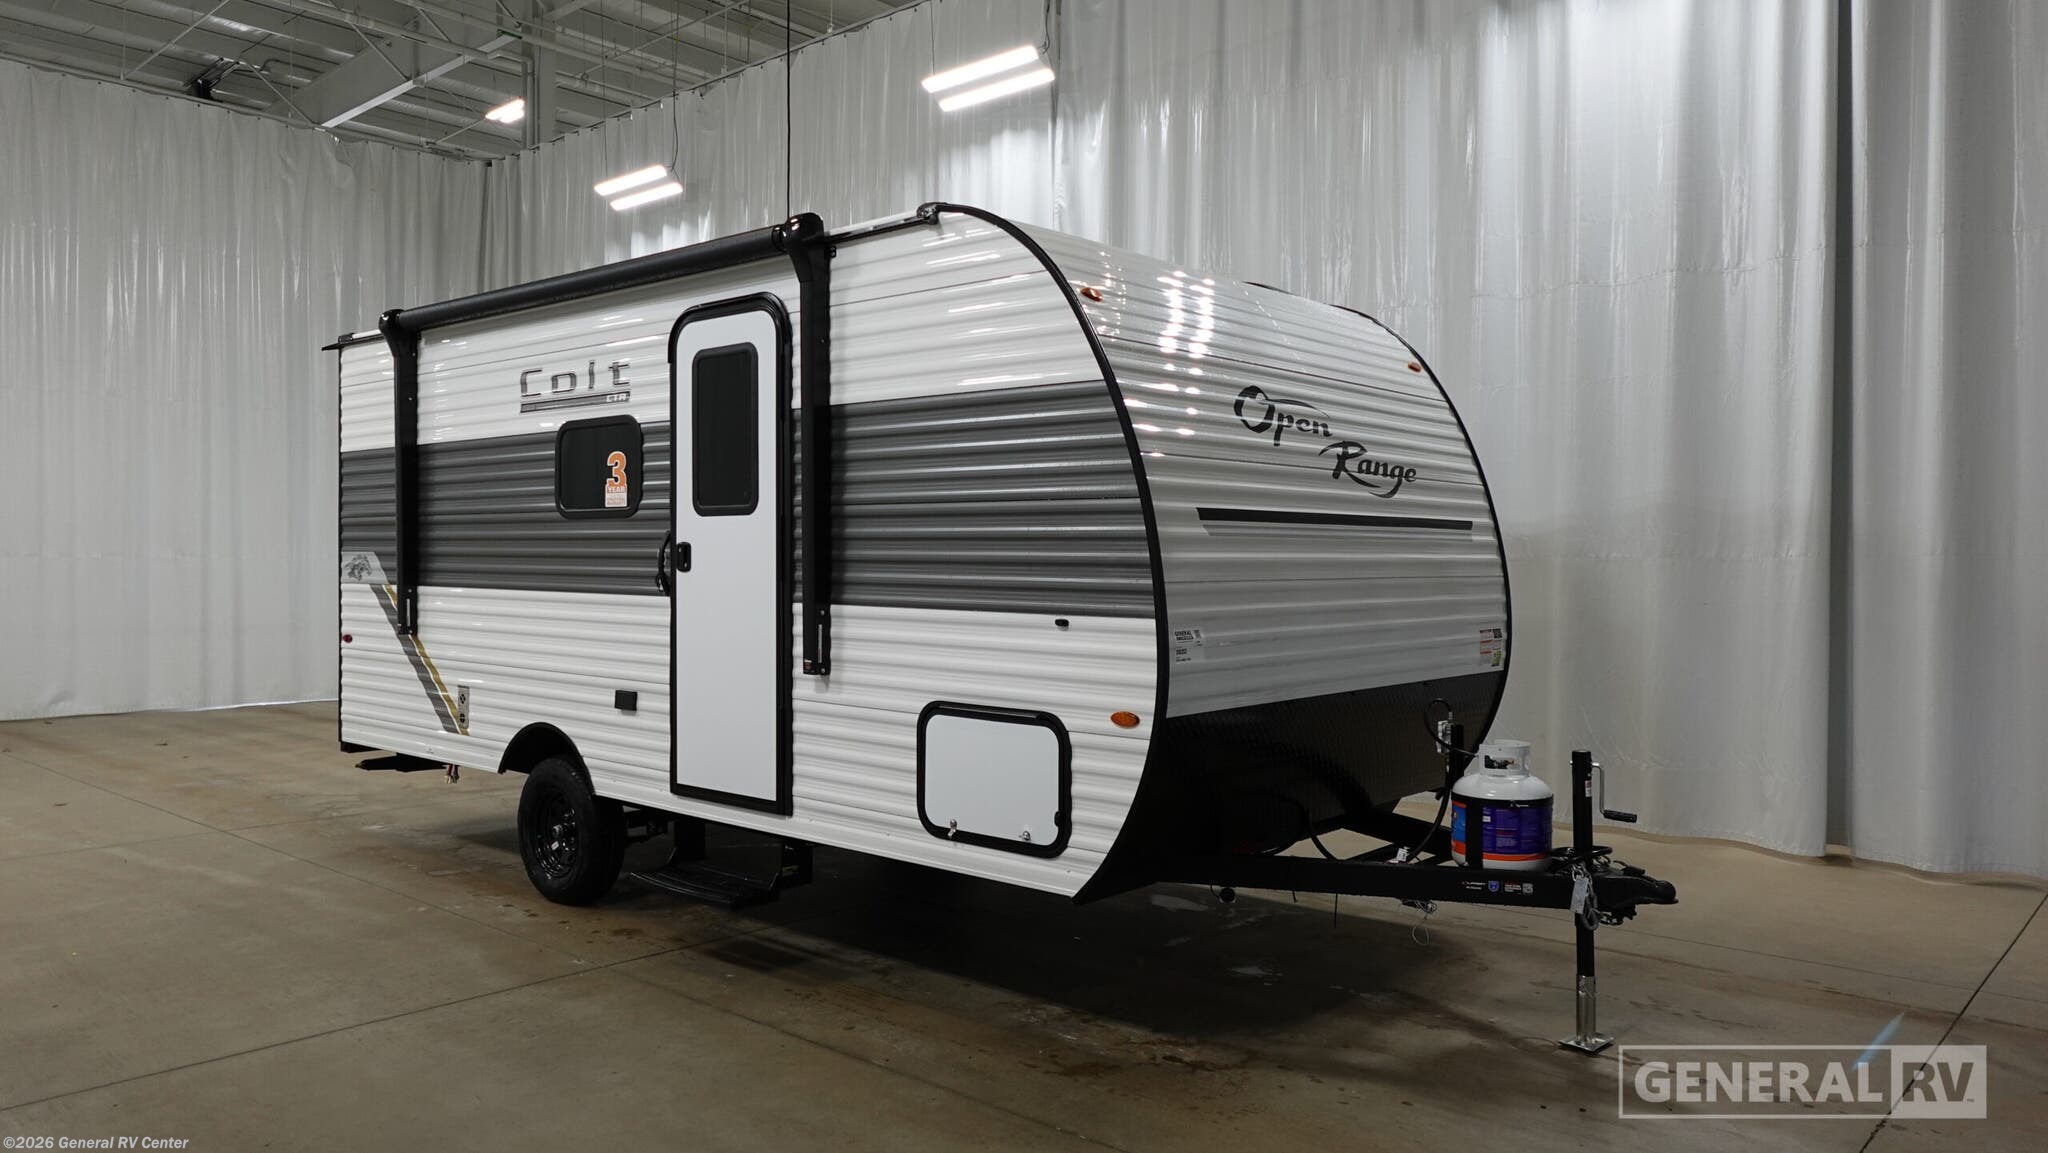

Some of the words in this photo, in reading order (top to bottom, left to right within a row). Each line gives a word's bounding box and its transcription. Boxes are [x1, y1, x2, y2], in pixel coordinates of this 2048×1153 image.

[520, 360, 630, 397] Colt
[1234, 385, 1332, 446] Open
[1318, 440, 1417, 498] Range
[607, 451, 627, 486] 3
[607, 485, 625, 493] YEAR
